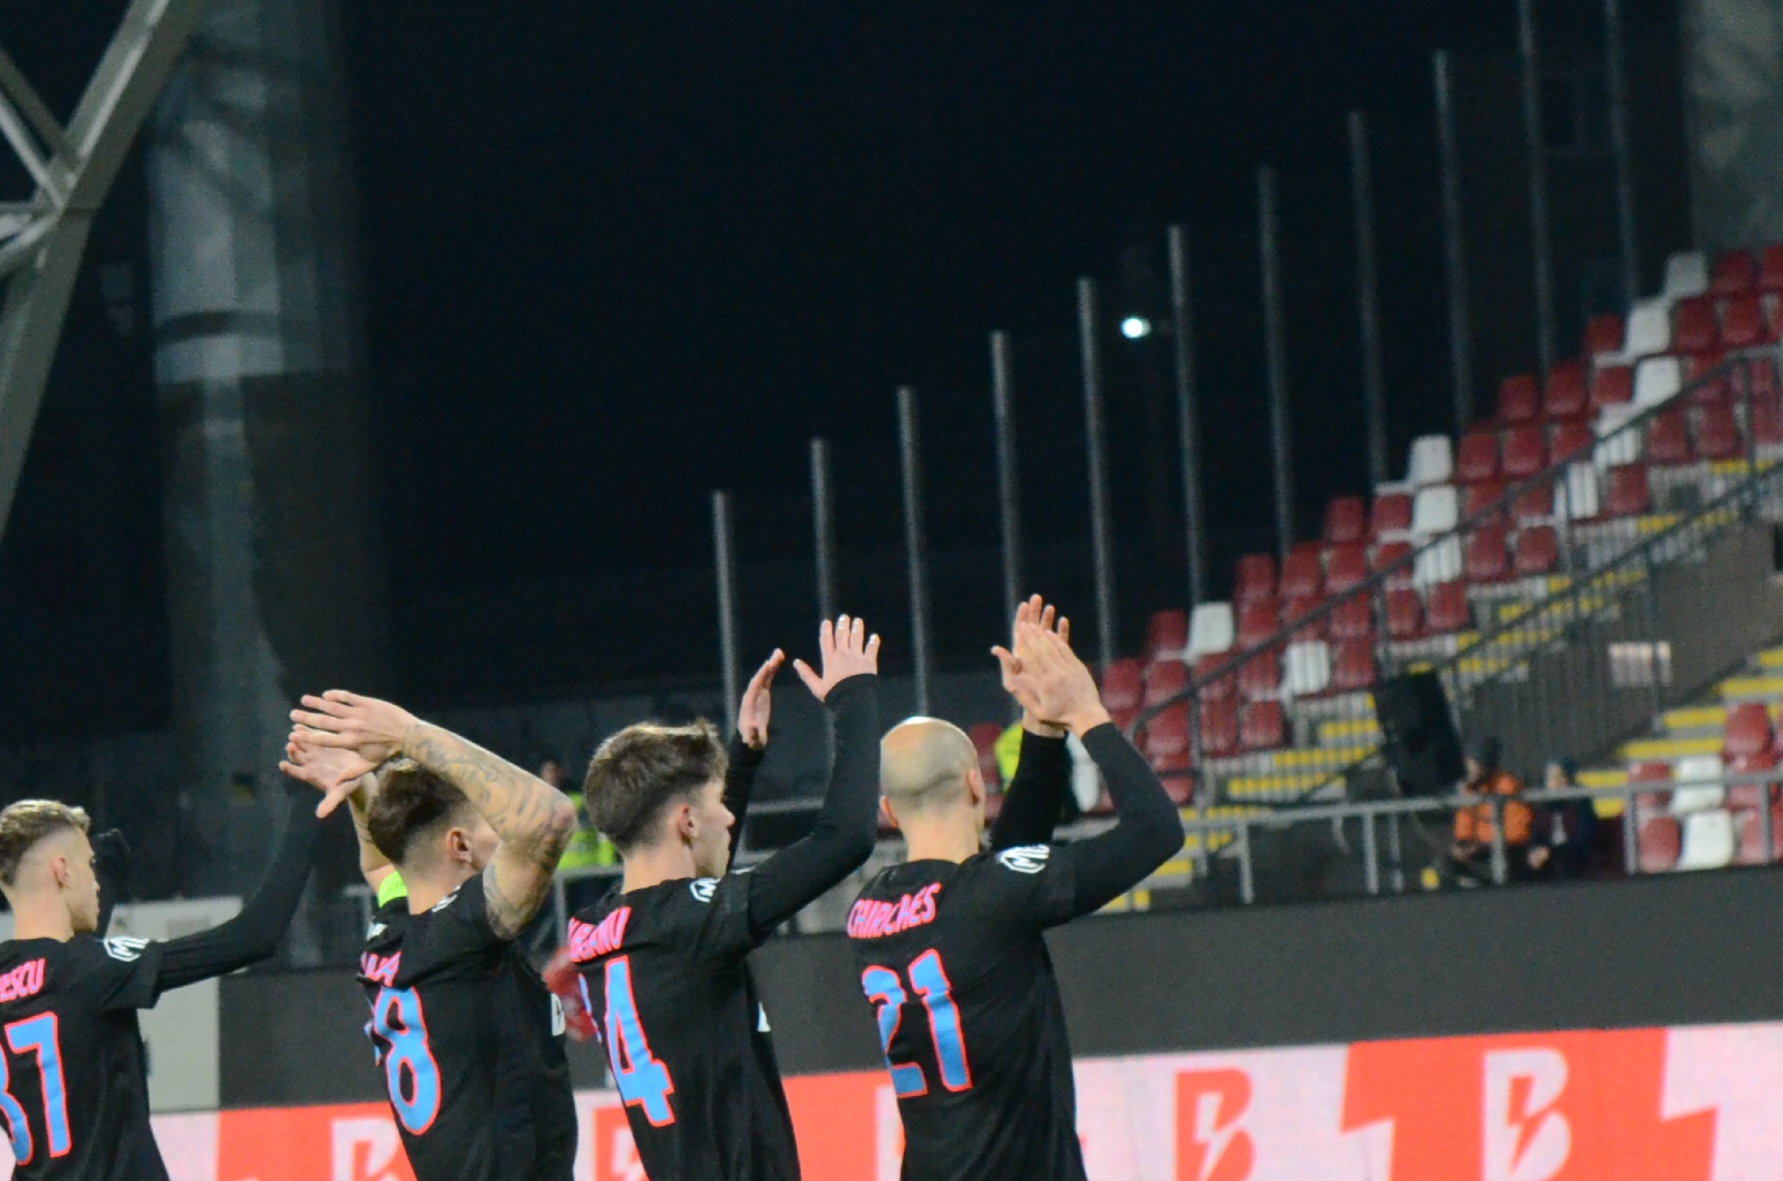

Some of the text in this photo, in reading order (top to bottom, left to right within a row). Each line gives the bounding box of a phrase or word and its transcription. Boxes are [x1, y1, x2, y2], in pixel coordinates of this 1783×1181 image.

[363, 986, 443, 1136] 8
[577, 954, 675, 1128] 4
[861, 948, 973, 1098] 21
